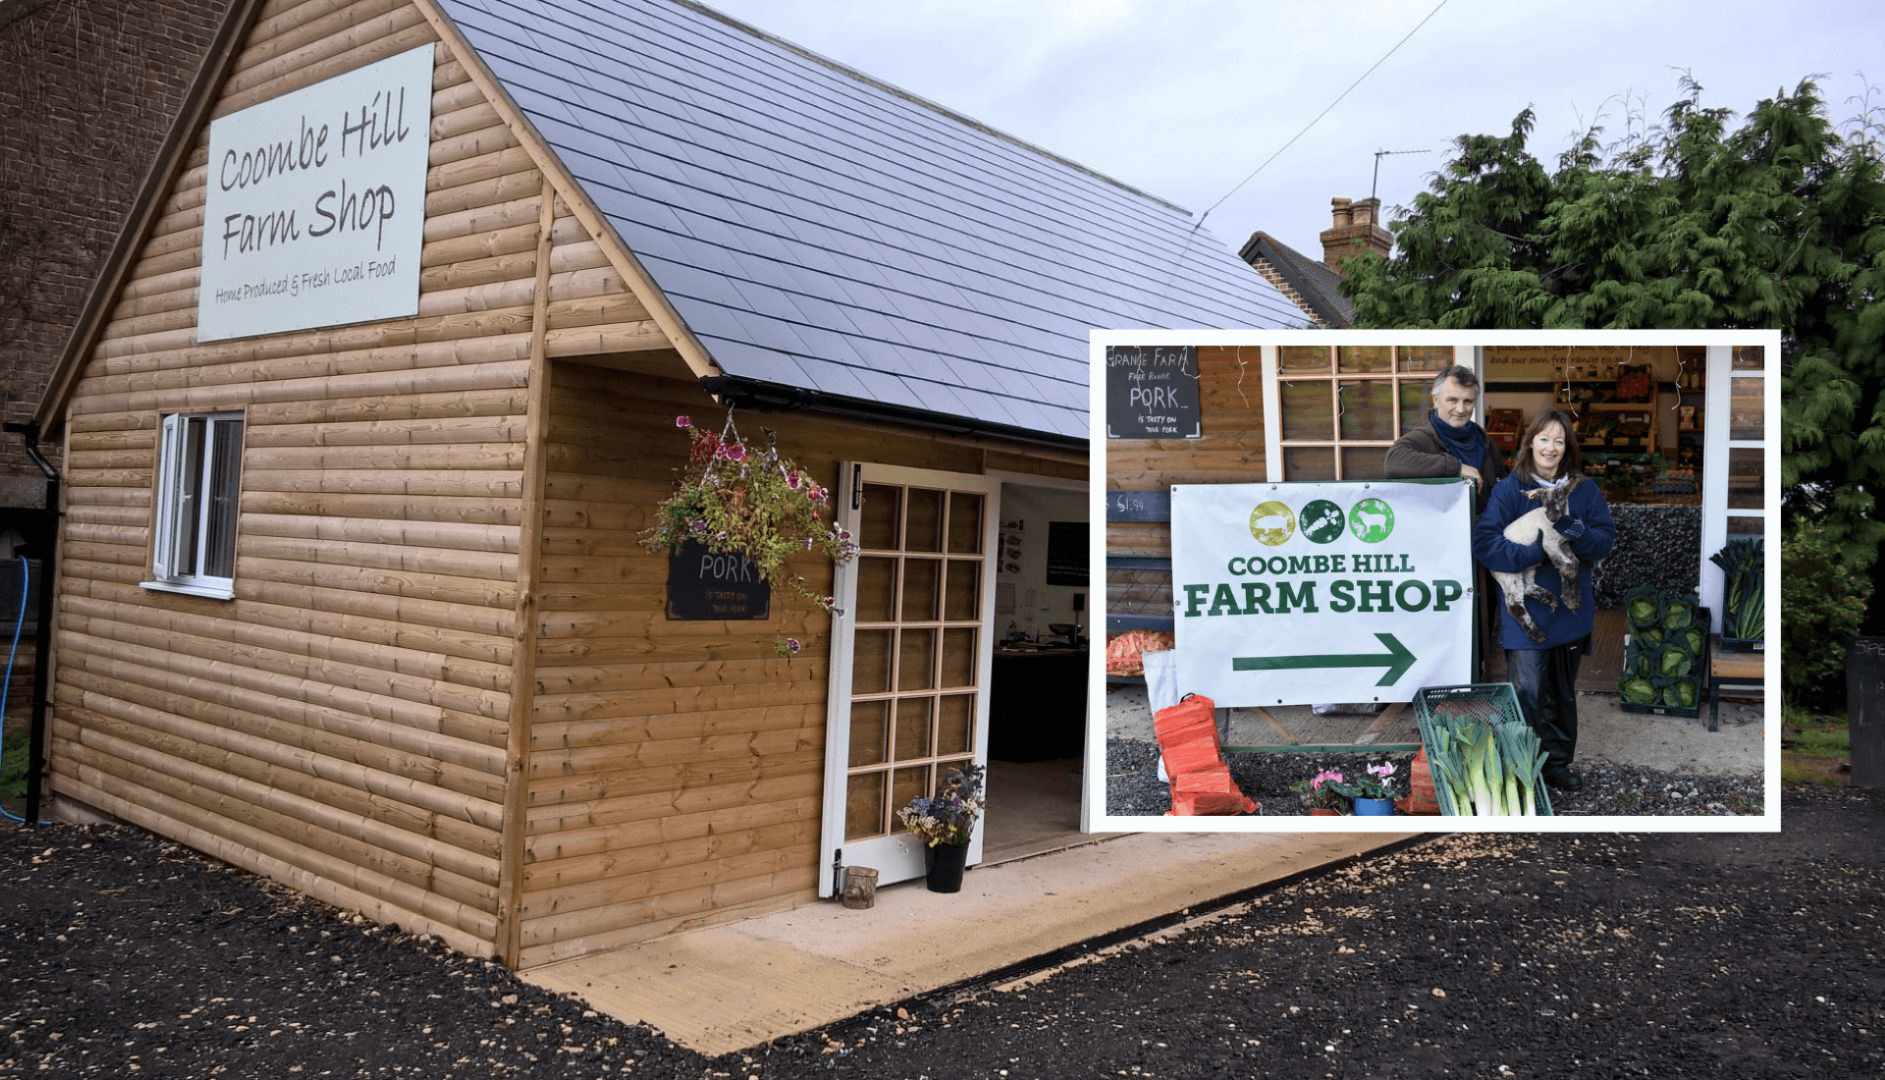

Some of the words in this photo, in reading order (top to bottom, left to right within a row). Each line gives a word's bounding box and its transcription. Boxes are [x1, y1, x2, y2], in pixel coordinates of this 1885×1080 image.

[220, 115, 328, 192] Coombe
[342, 86, 409, 157] Hill
[223, 209, 300, 260] Farm
[308, 178, 395, 251] Shop
[215, 287, 241, 304] Home
[243, 273, 288, 299] Produced
[290, 274, 299, 297] &
[301, 267, 330, 290] Fresh
[334, 261, 364, 284] Local
[368, 254, 396, 279] Food
[1490, 355, 1509, 364] and
[1571, 356, 1599, 367] range
[1117, 494, 1144, 513] £1.99
[700, 554, 751, 582] PORK
[1227, 555, 1346, 576] COOMBE
[1352, 553, 1415, 573] HILL
[1183, 580, 1319, 618] FARM
[1329, 579, 1463, 613] SHOP
